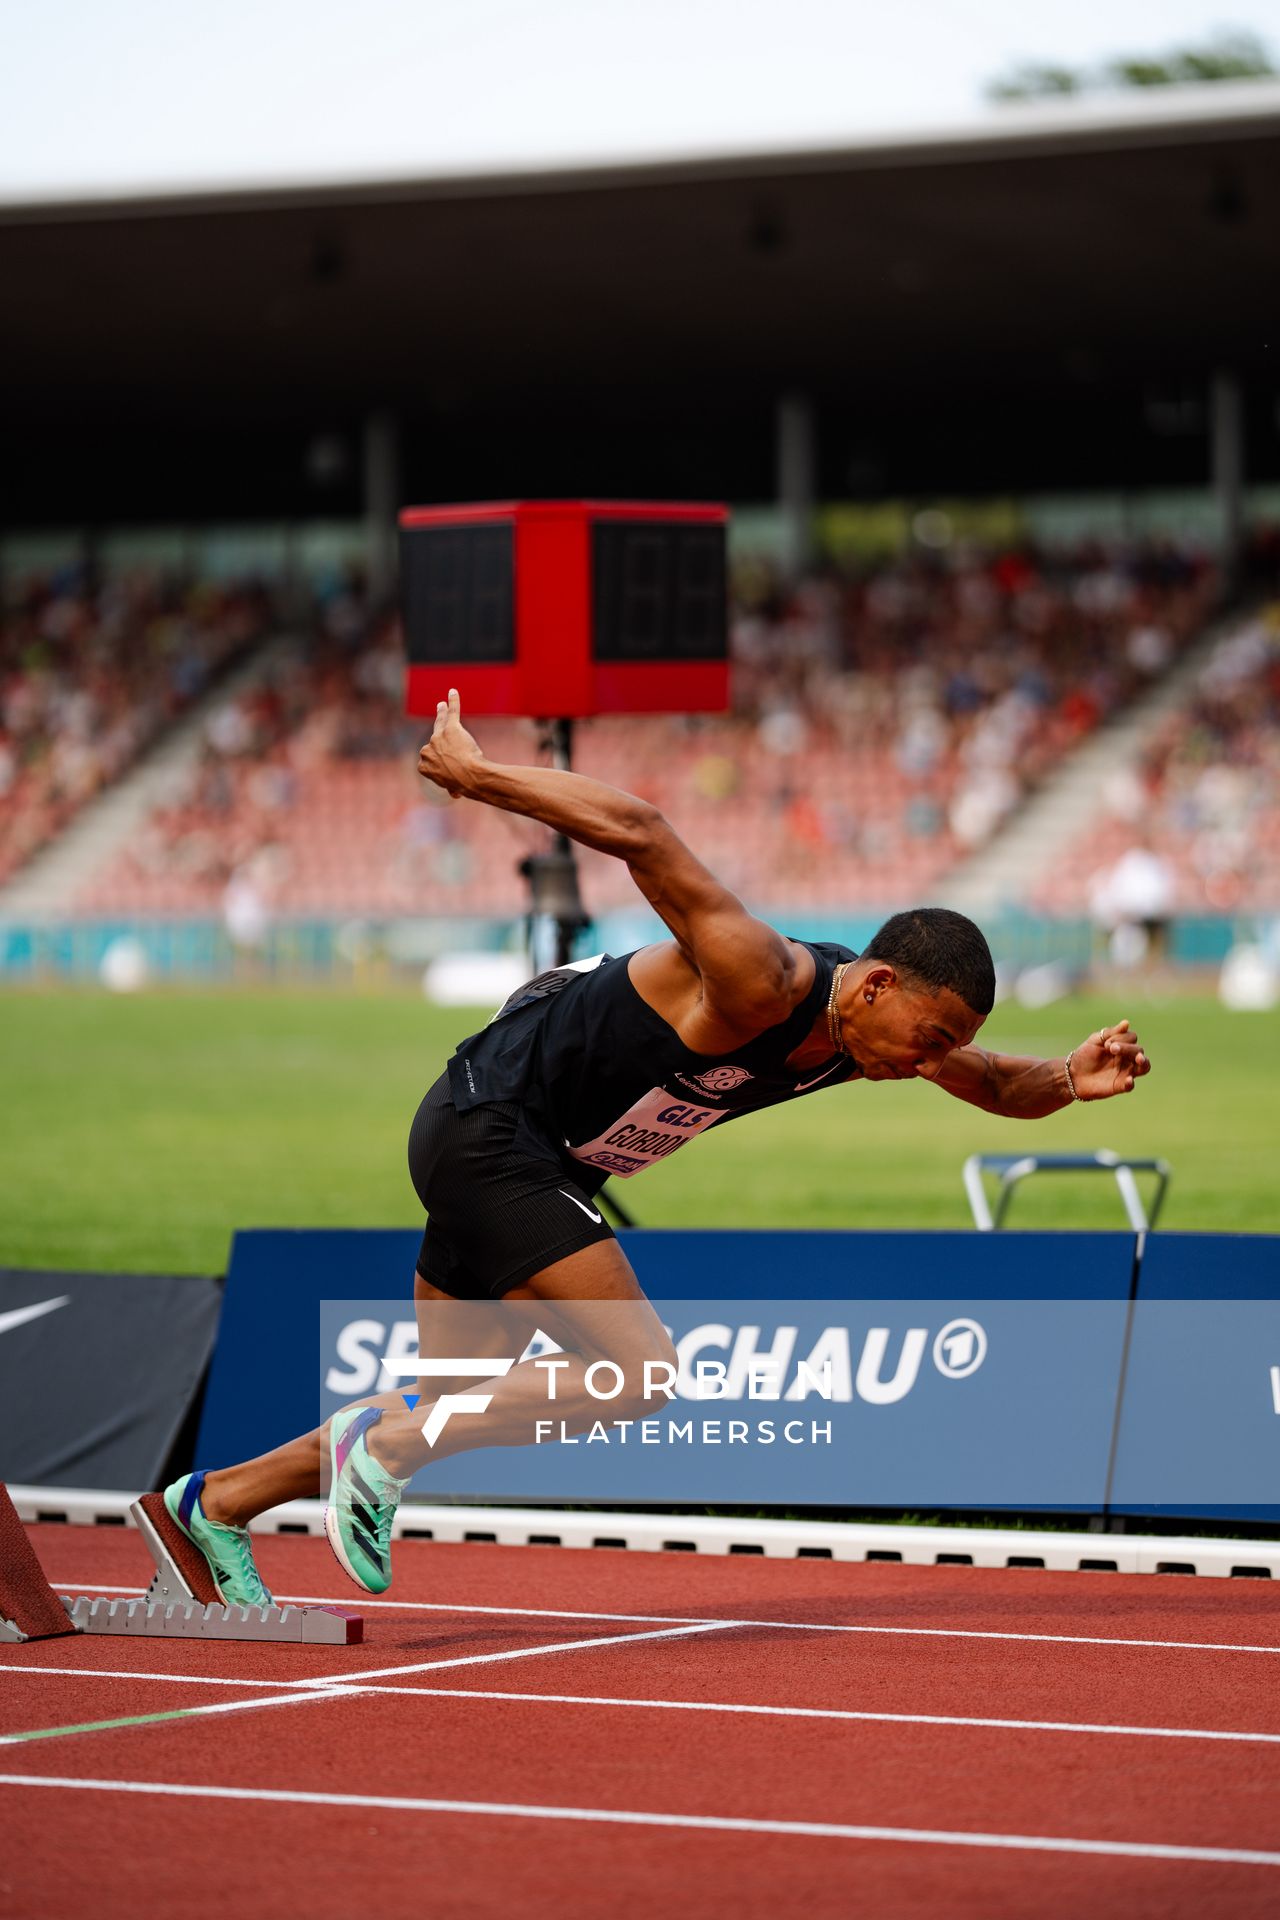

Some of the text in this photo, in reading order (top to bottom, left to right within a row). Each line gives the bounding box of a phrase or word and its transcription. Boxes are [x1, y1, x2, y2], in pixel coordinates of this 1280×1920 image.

[656, 1105, 712, 1128] GLS
[604, 1124, 690, 1156] GORDON
[325, 1319, 929, 1405] SPCHAU
